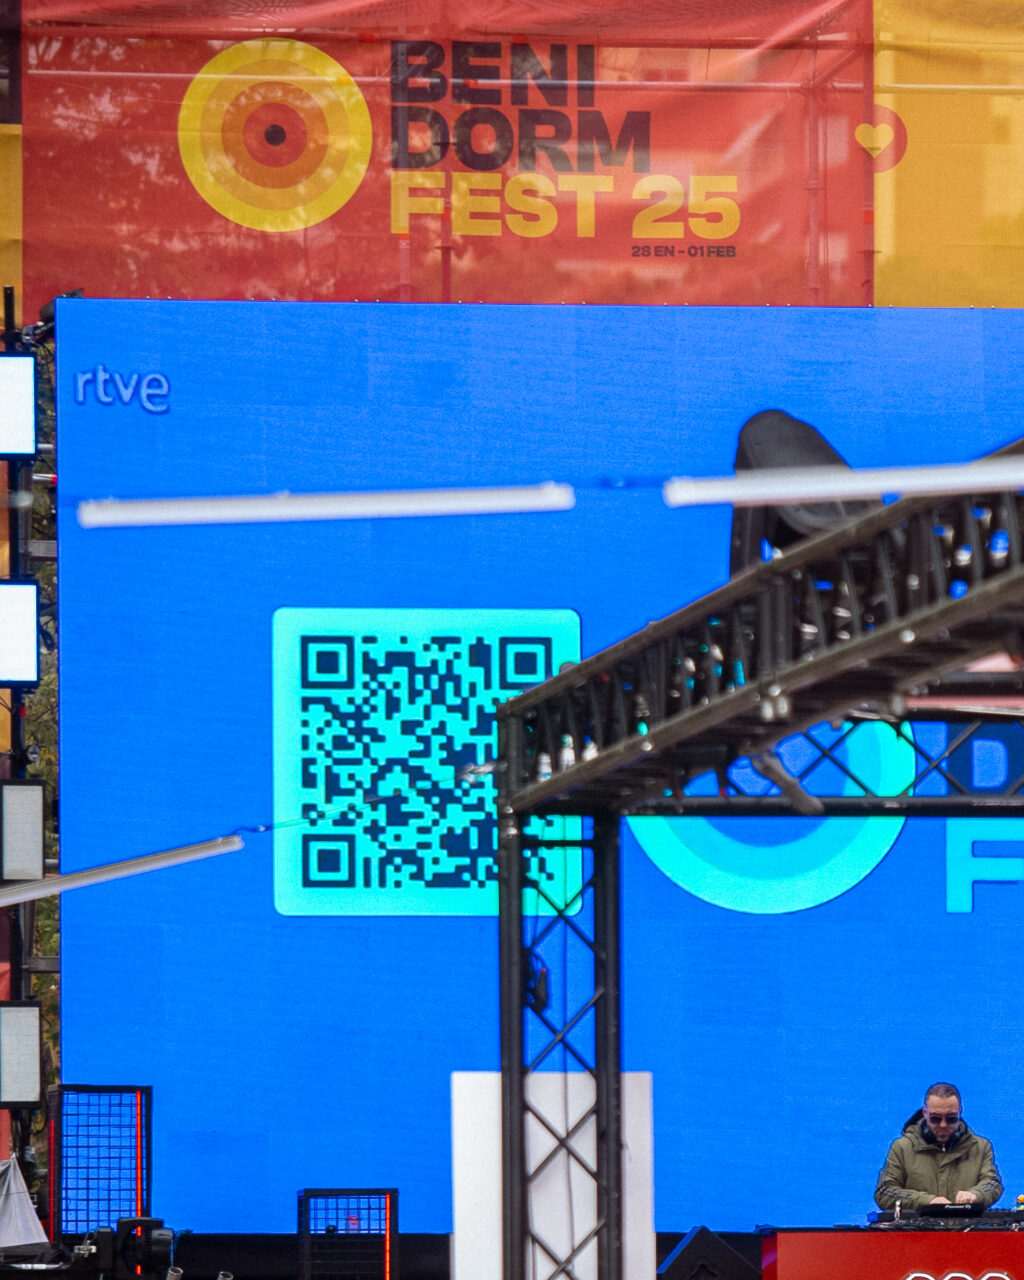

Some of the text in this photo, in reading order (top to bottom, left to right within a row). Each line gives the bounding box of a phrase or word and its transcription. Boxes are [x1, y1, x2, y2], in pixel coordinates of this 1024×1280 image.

[390, 40, 595, 107] BENI
[390, 105, 650, 173] DORM
[390, 171, 741, 239] FEST 25
[631, 245, 651, 258] 28
[654, 245, 675, 258] EN
[688, 245, 704, 258] 01
[707, 245, 736, 258] FEB
[76, 364, 169, 411] rtve
